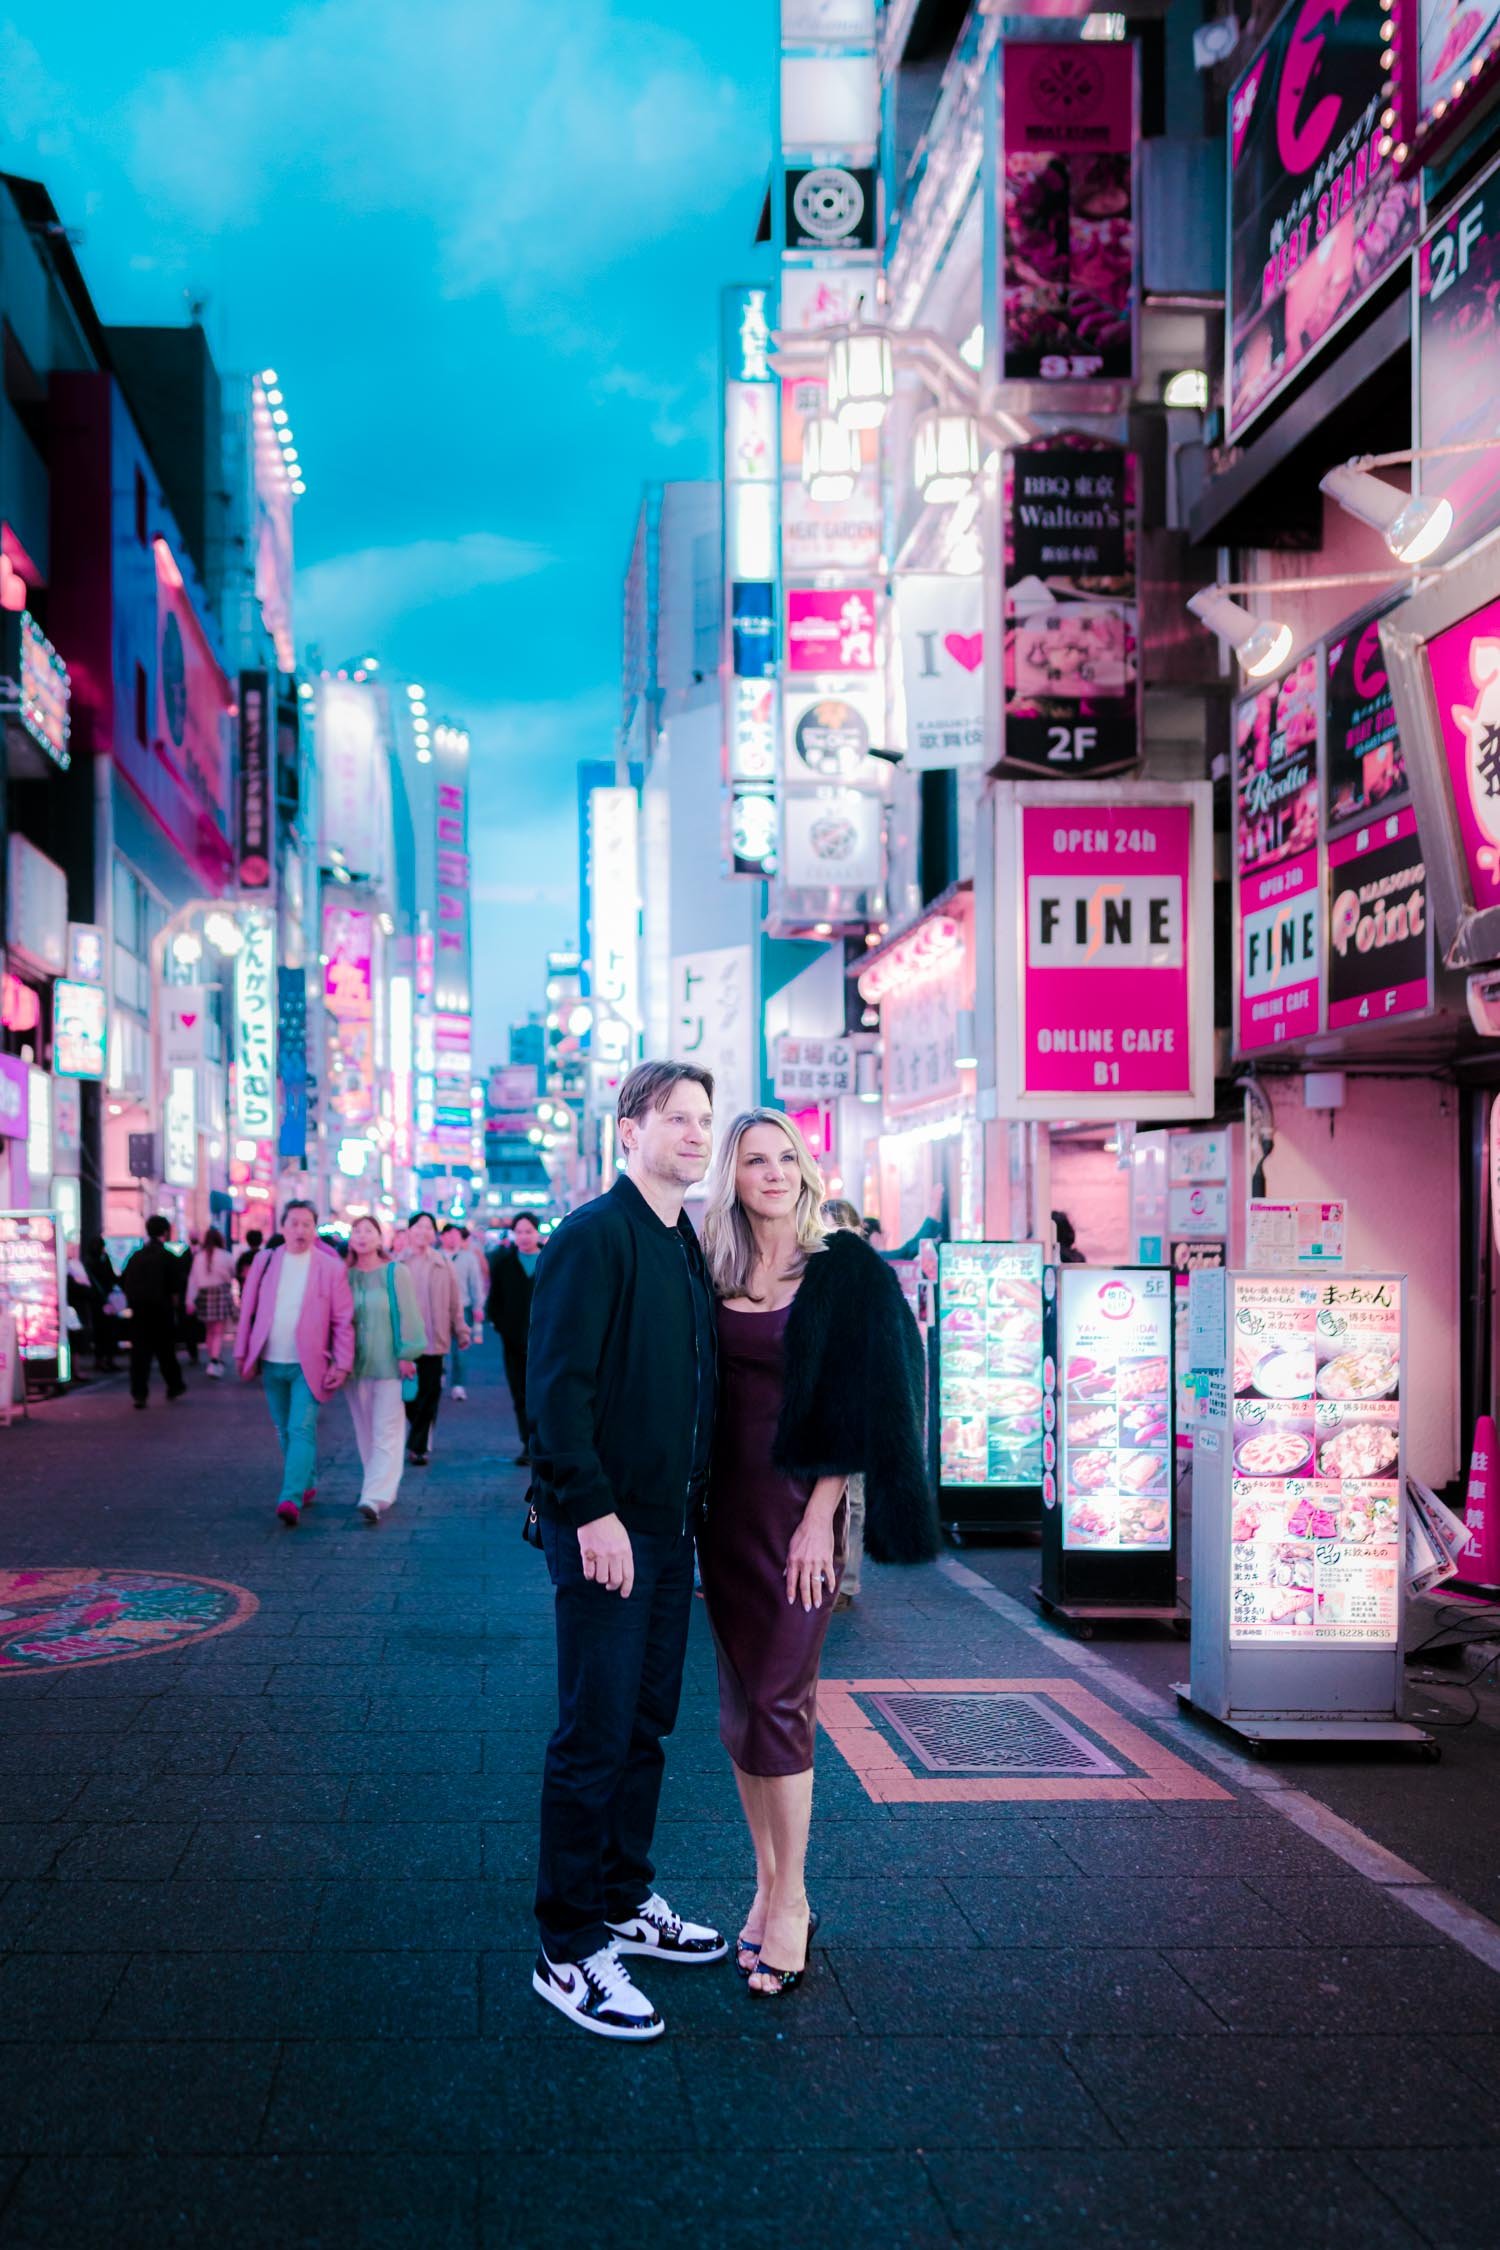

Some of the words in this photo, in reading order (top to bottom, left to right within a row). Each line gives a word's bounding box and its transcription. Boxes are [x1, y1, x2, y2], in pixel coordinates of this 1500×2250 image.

[1262, 213, 1311, 305] MEAT
[1430, 200, 1484, 303] 2F
[1024, 475, 1069, 497] BBQ
[1019, 503, 1120, 529] Walton's
[916, 629, 941, 678] I
[1047, 726, 1098, 761] 2F
[1053, 829, 1109, 853] OPEN
[1115, 829, 1157, 853] 24h
[1041, 898, 1170, 944] FINE
[1332, 889, 1425, 957] Point
[1249, 912, 1314, 978] FINE
[1358, 999, 1370, 1018] 4
[1385, 991, 1397, 1012] F
[1037, 1028, 1114, 1053] ONLINE
[1122, 1028, 1175, 1053] CAFE
[1093, 1061, 1120, 1085] B1
[1145, 1280, 1165, 1294] 5F
[1322, 1284, 1393, 1308] まっちゃん
[1464, 1451, 1488, 1557] 駐車禁止
